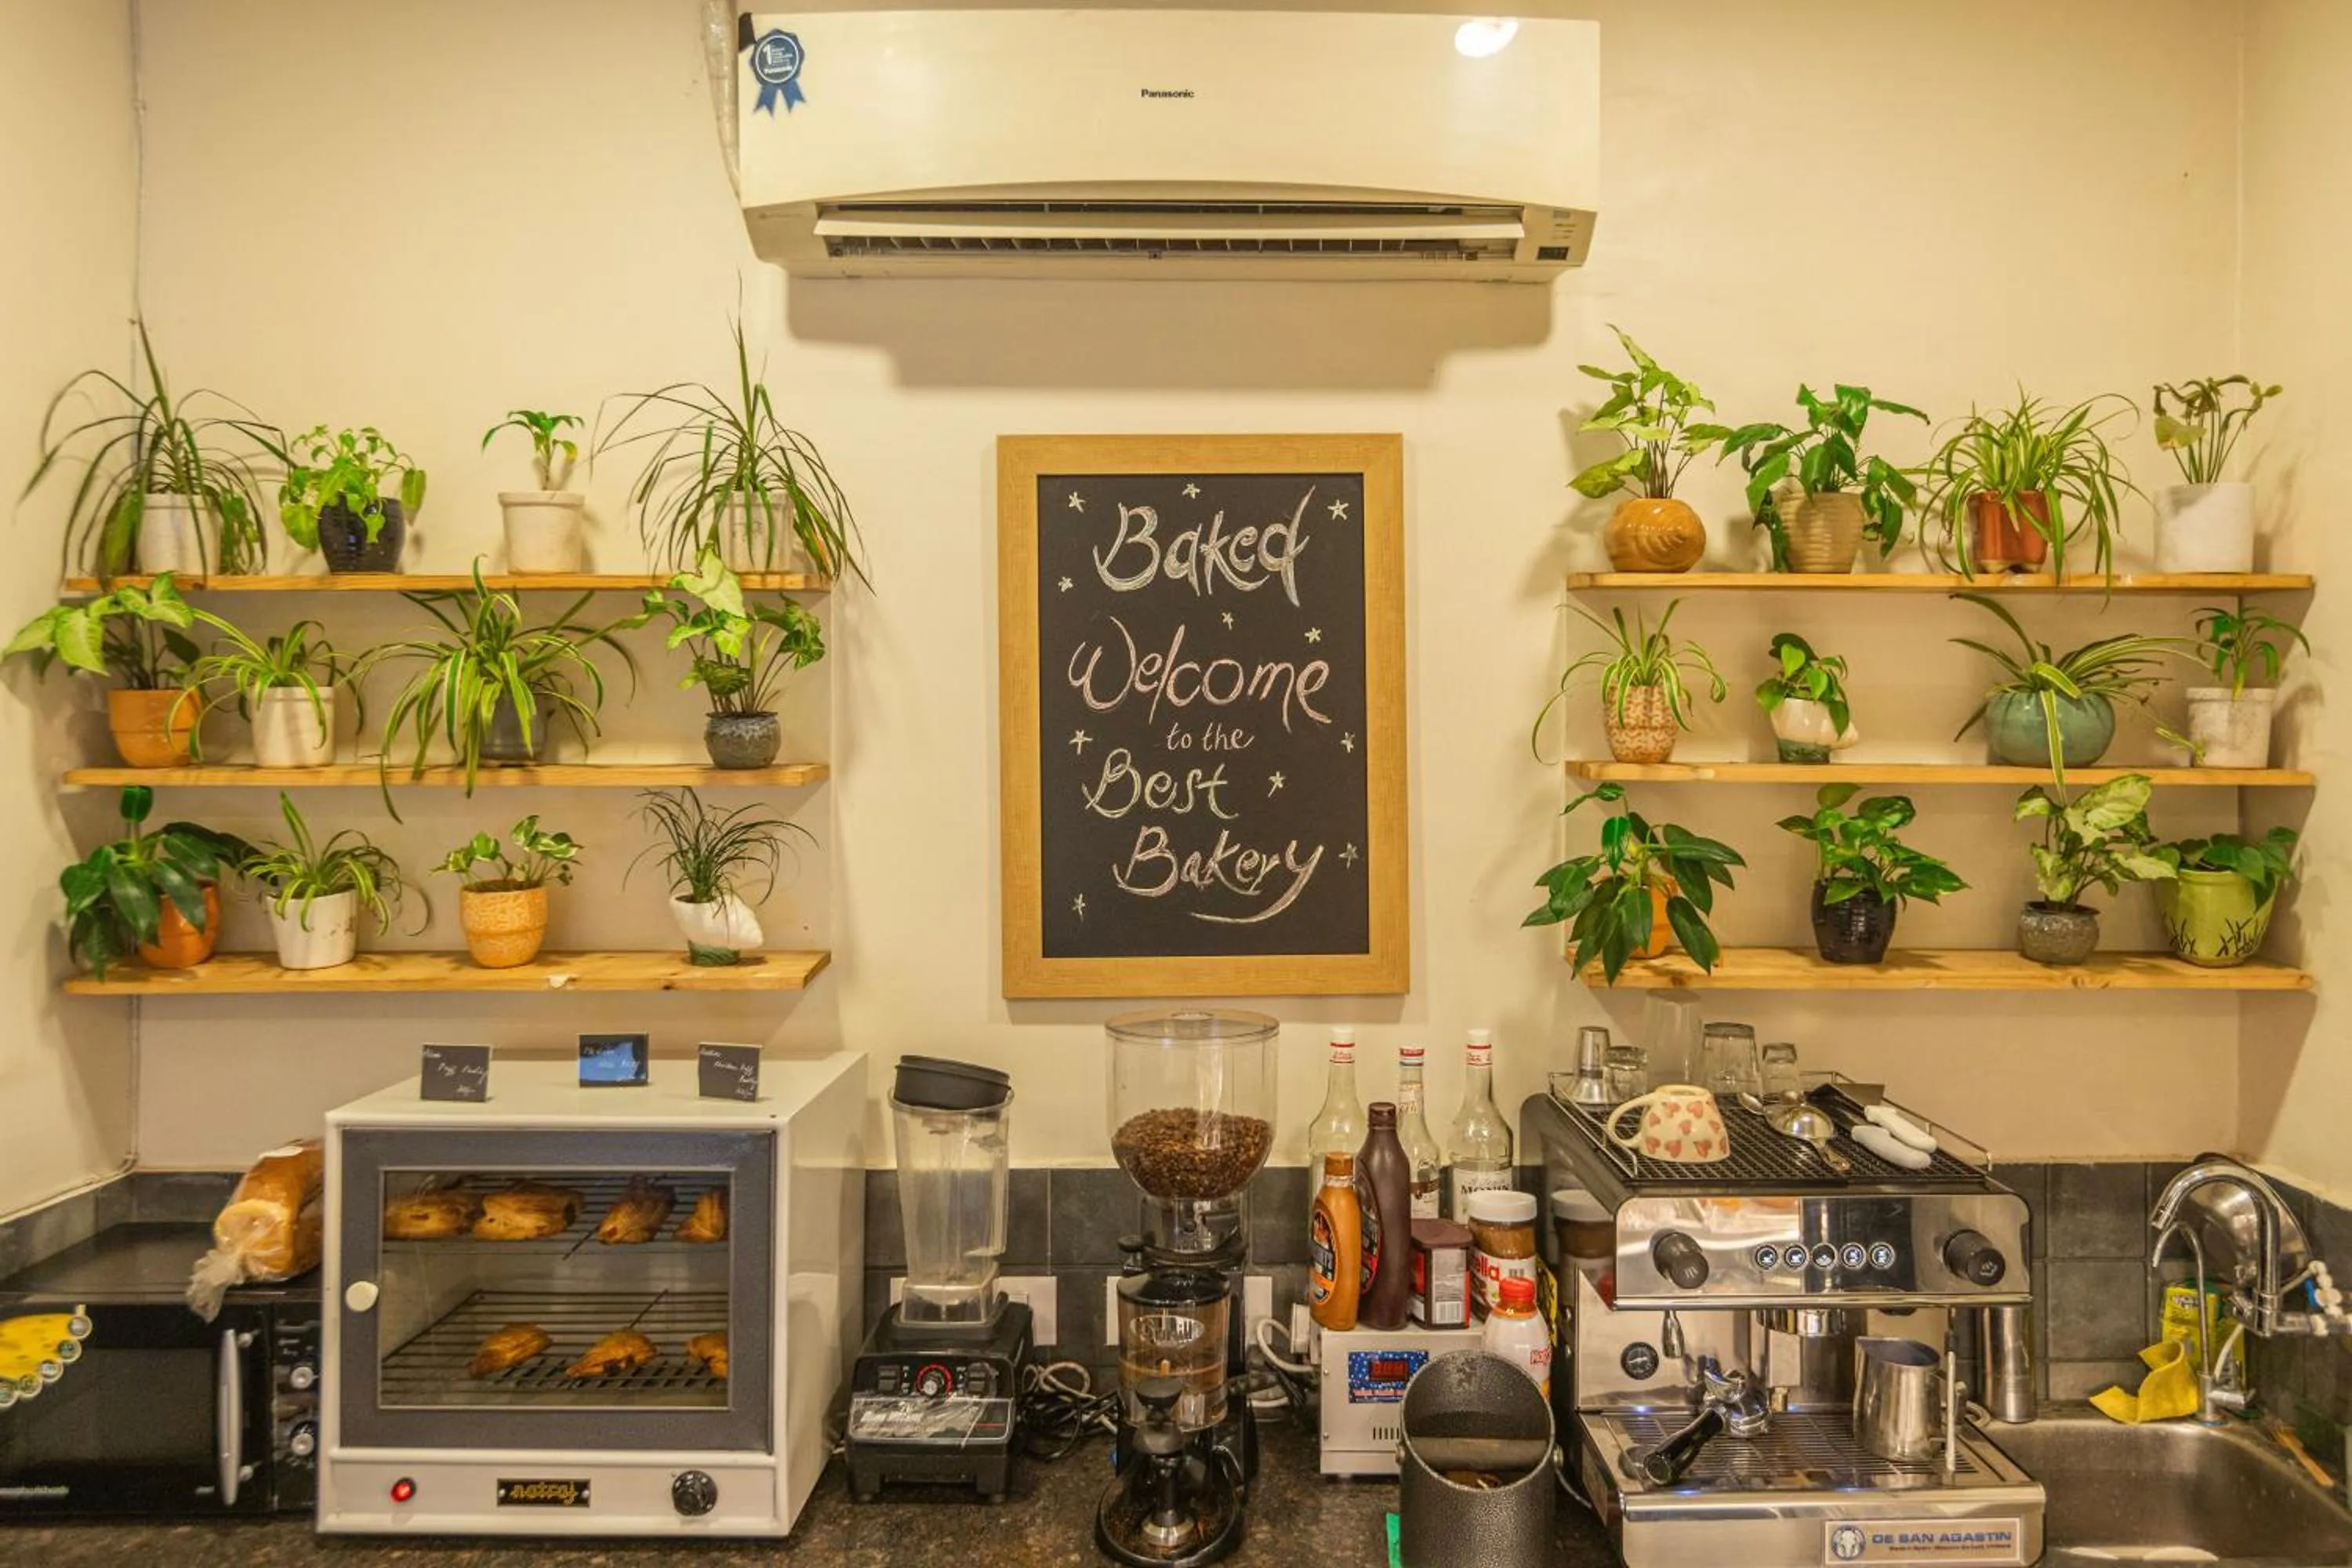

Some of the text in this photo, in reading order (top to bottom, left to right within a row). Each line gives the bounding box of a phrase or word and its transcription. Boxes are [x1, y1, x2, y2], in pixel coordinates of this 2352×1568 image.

[1093, 485, 1316, 608] Baked
[1068, 615, 1332, 732] Welcome
[1167, 720, 1254, 752] to the
[1082, 747, 1240, 819] Best
[1112, 825, 1325, 924] Bakery
[1899, 1533, 1934, 1543] SAN
